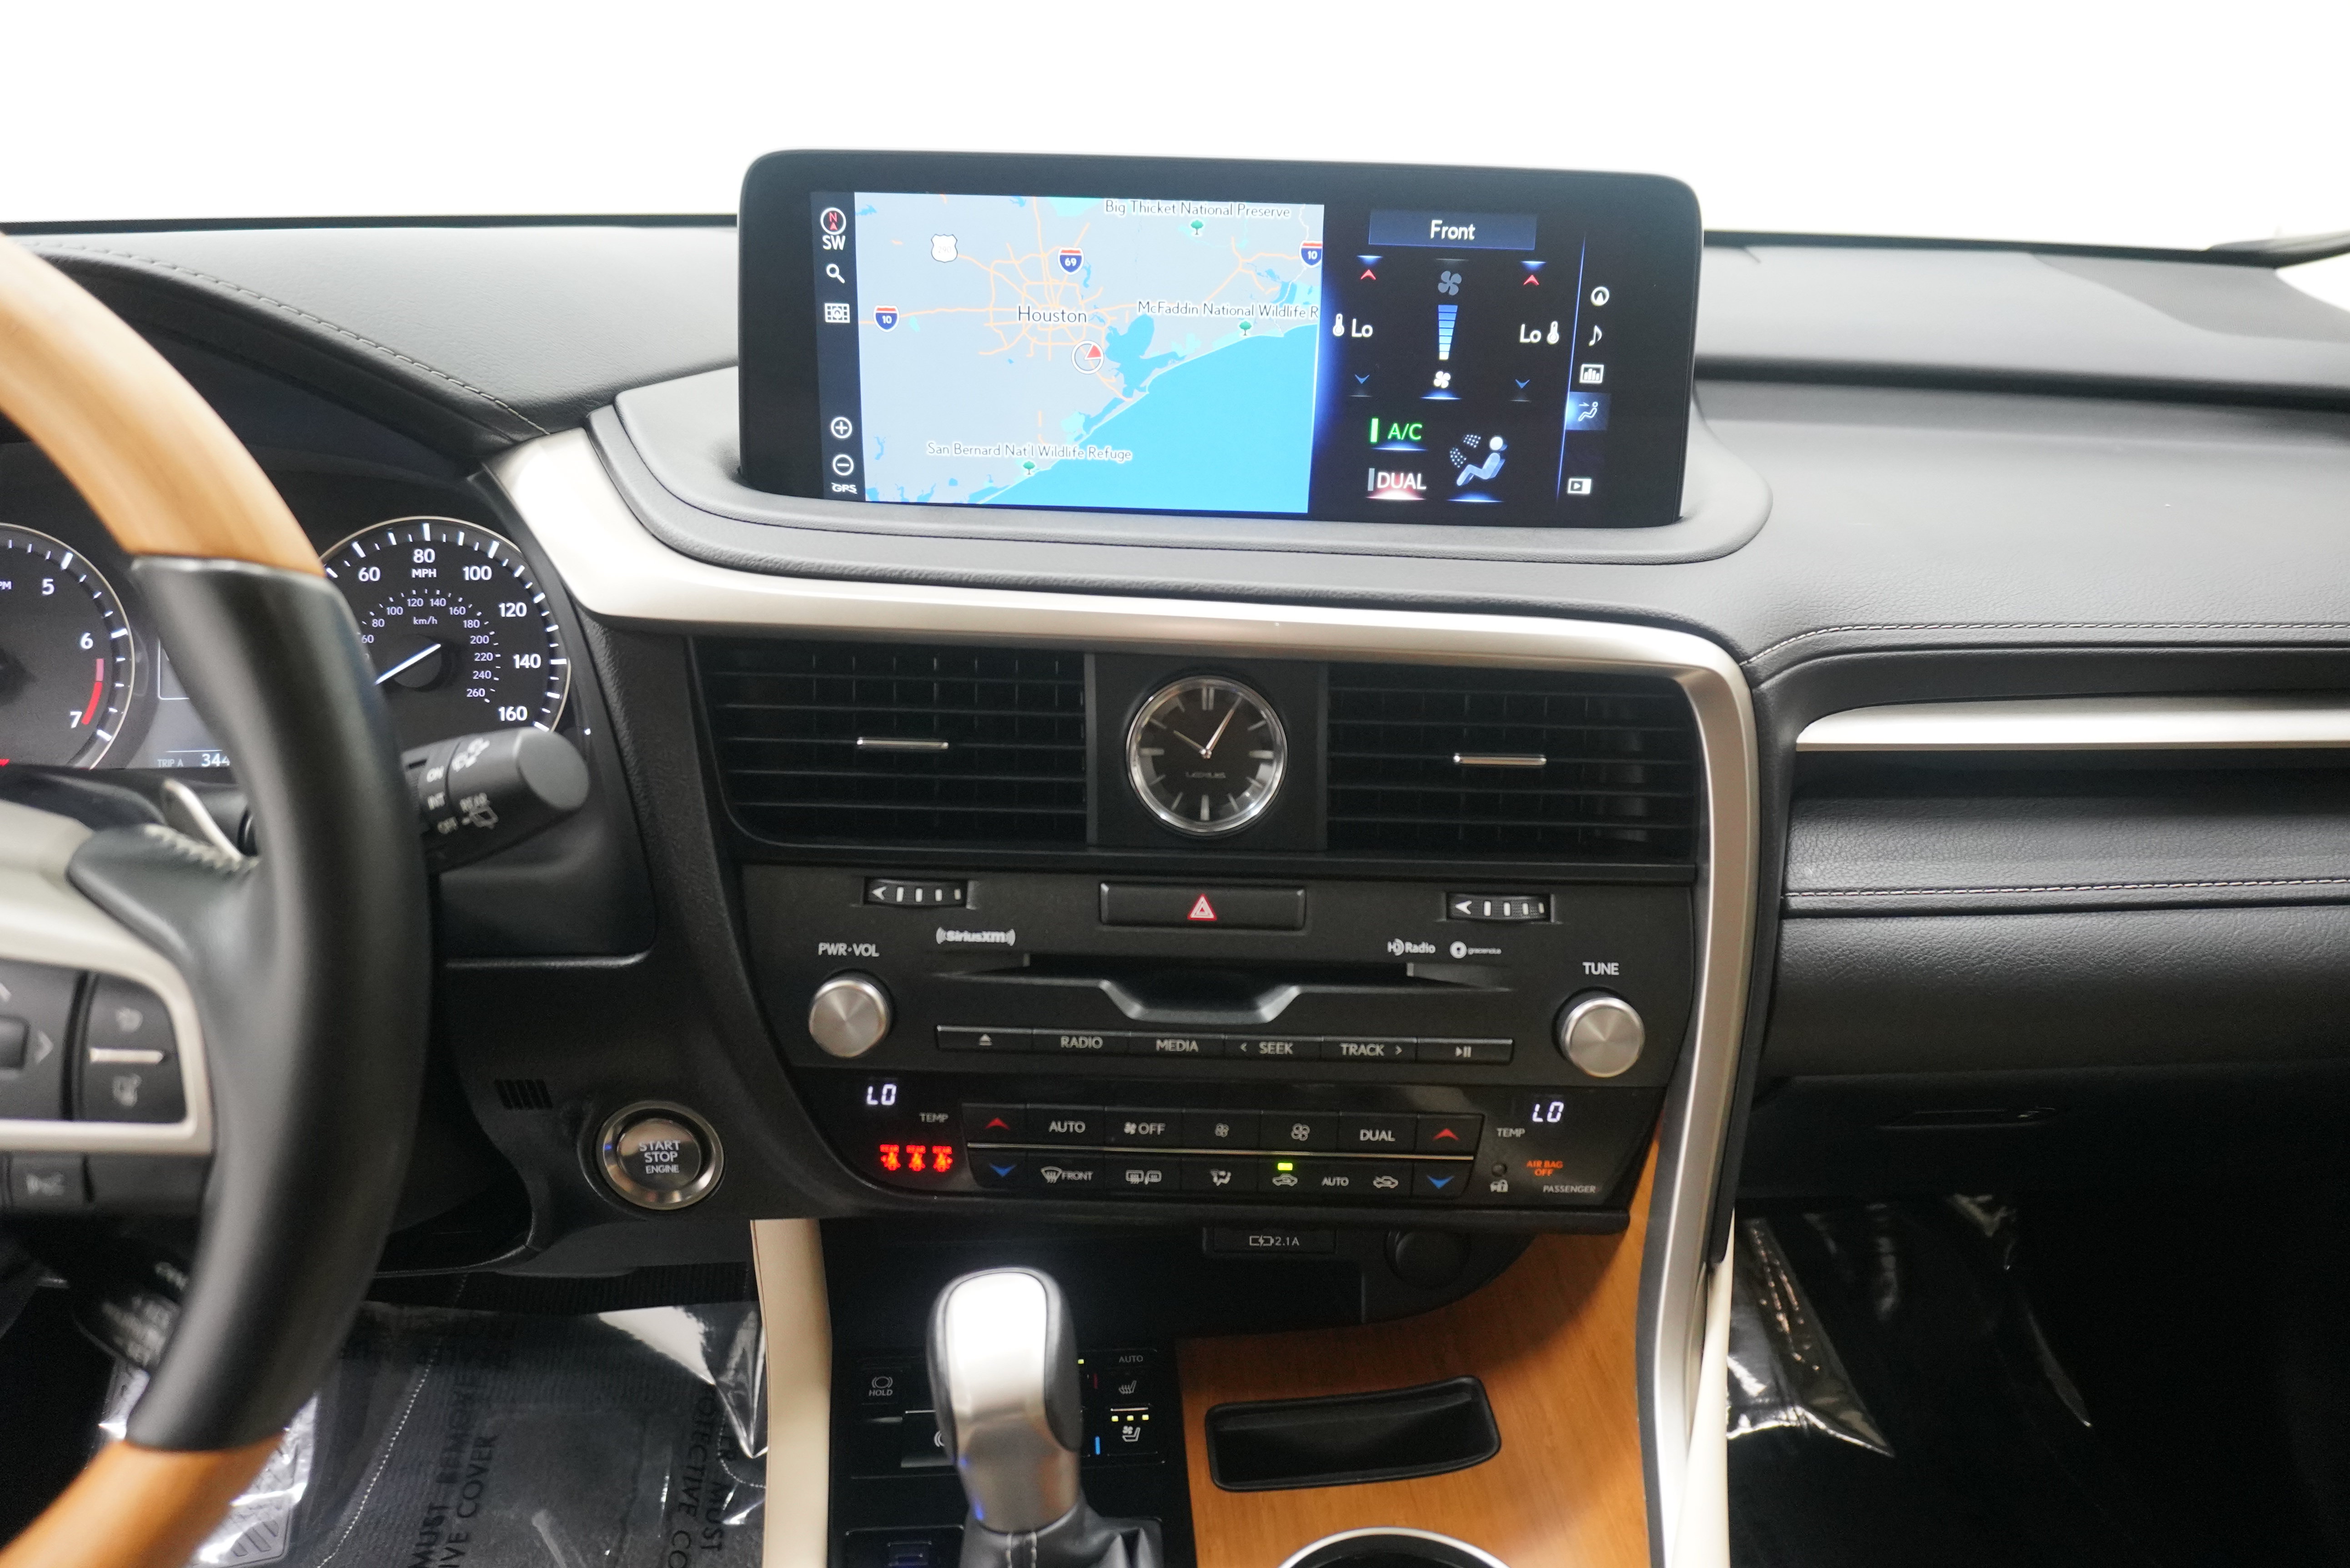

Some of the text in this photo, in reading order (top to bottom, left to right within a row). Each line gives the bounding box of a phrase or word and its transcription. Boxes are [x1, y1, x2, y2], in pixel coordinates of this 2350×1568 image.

[1105, 200, 1290, 218] Big Thicket National Preserve
[1430, 220, 1476, 241] Front
[823, 235, 846, 251] SW
[1065, 257, 1076, 266] 69
[1308, 251, 1318, 260] 10
[1018, 305, 1087, 323] Houston
[1138, 301, 1319, 318] McFaddin National Wildlife R
[882, 315, 892, 325] 10
[1351, 319, 1373, 337] Lo
[1520, 324, 1541, 343] Lo
[1388, 423, 1422, 441] A/C
[928, 442, 1132, 461] San Bernard Nat'l Wildlife Refuge
[1377, 472, 1426, 490] DUAL
[832, 483, 857, 493] GPS
[413, 548, 435, 563] 80
[358, 567, 381, 582] 60
[412, 568, 437, 578] MPH
[463, 566, 492, 581] 100
[41, 578, 55, 595] 5
[407, 598, 424, 608] 120
[430, 598, 447, 608] 140
[387, 606, 403, 616] 100
[449, 606, 466, 616] 160
[499, 603, 527, 618] 120
[372, 618, 385, 628] 80
[413, 616, 437, 626] km/h
[463, 619, 480, 629] 180
[80, 633, 93, 649] 6
[362, 634, 374, 643] 60
[470, 635, 489, 644] 200
[474, 652, 493, 662] 220
[513, 654, 541, 669] 140
[472, 670, 492, 680] 240
[467, 688, 485, 698] 260
[70, 711, 83, 728] 7
[499, 706, 527, 721] 160
[157, 759, 175, 767] TRIP
[177, 759, 184, 767] A
[1405, 941, 1436, 954] Radio
[1582, 962, 1619, 975] TUNE
[1060, 1035, 1103, 1049] RADIO
[1156, 1039, 1199, 1053] MEDIA
[1259, 1042, 1293, 1055] SEEK
[1340, 1043, 1385, 1056] TRACK
[919, 1112, 948, 1123] TEMP
[1049, 1121, 1085, 1133] AUTO
[1138, 1123, 1166, 1135] OFF
[1496, 1128, 1525, 1137] TEMP
[1360, 1130, 1395, 1142] DUAL
[639, 1140, 680, 1151] START
[645, 1151, 678, 1163] STOP
[646, 1165, 679, 1174] ENGINE
[1526, 1160, 1563, 1169] AIR BAG
[1061, 1171, 1094, 1181] FRONT
[1534, 1168, 1553, 1177] OFF
[1321, 1177, 1349, 1186] AUTO
[1543, 1185, 1596, 1193] PASSENGER
[1275, 1236, 1300, 1246] 2.1A
[457, 1435, 499, 1519] COVER
[699, 1481, 732, 1552] MUST
